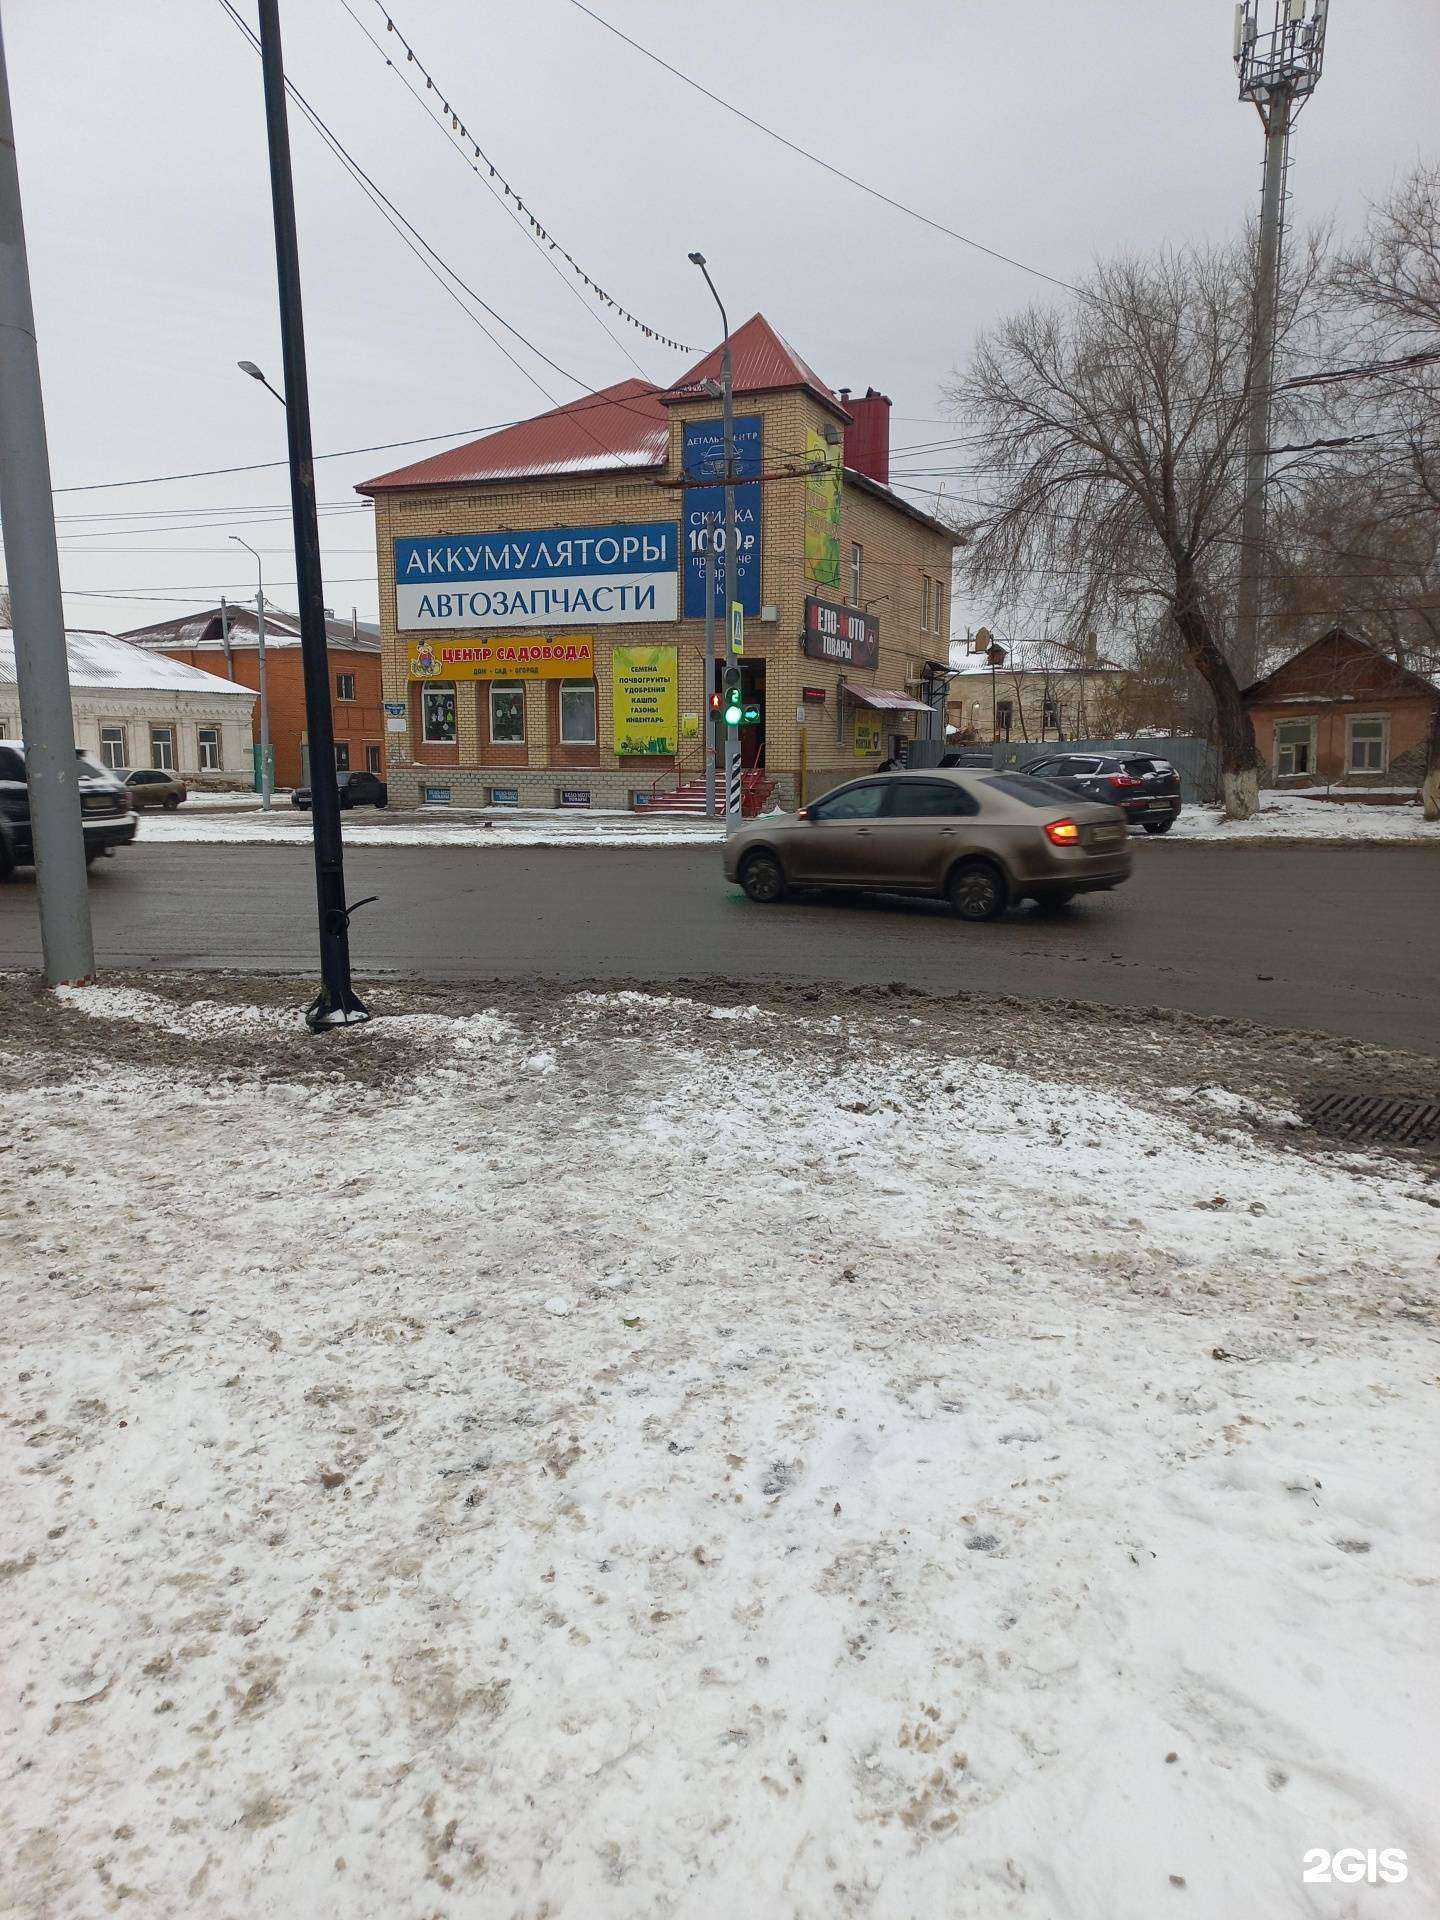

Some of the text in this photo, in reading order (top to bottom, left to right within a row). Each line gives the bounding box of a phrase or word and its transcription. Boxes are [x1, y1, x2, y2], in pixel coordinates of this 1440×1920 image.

[406, 535, 666, 575] АККУМУЛЯТОРЫ
[417, 585, 655, 618] АВТОЗАПЧАСТИ
[441, 644, 591, 663] ЦЕНТР САДОВОДА
[822, 635, 852, 659] ТОВАРЫ
